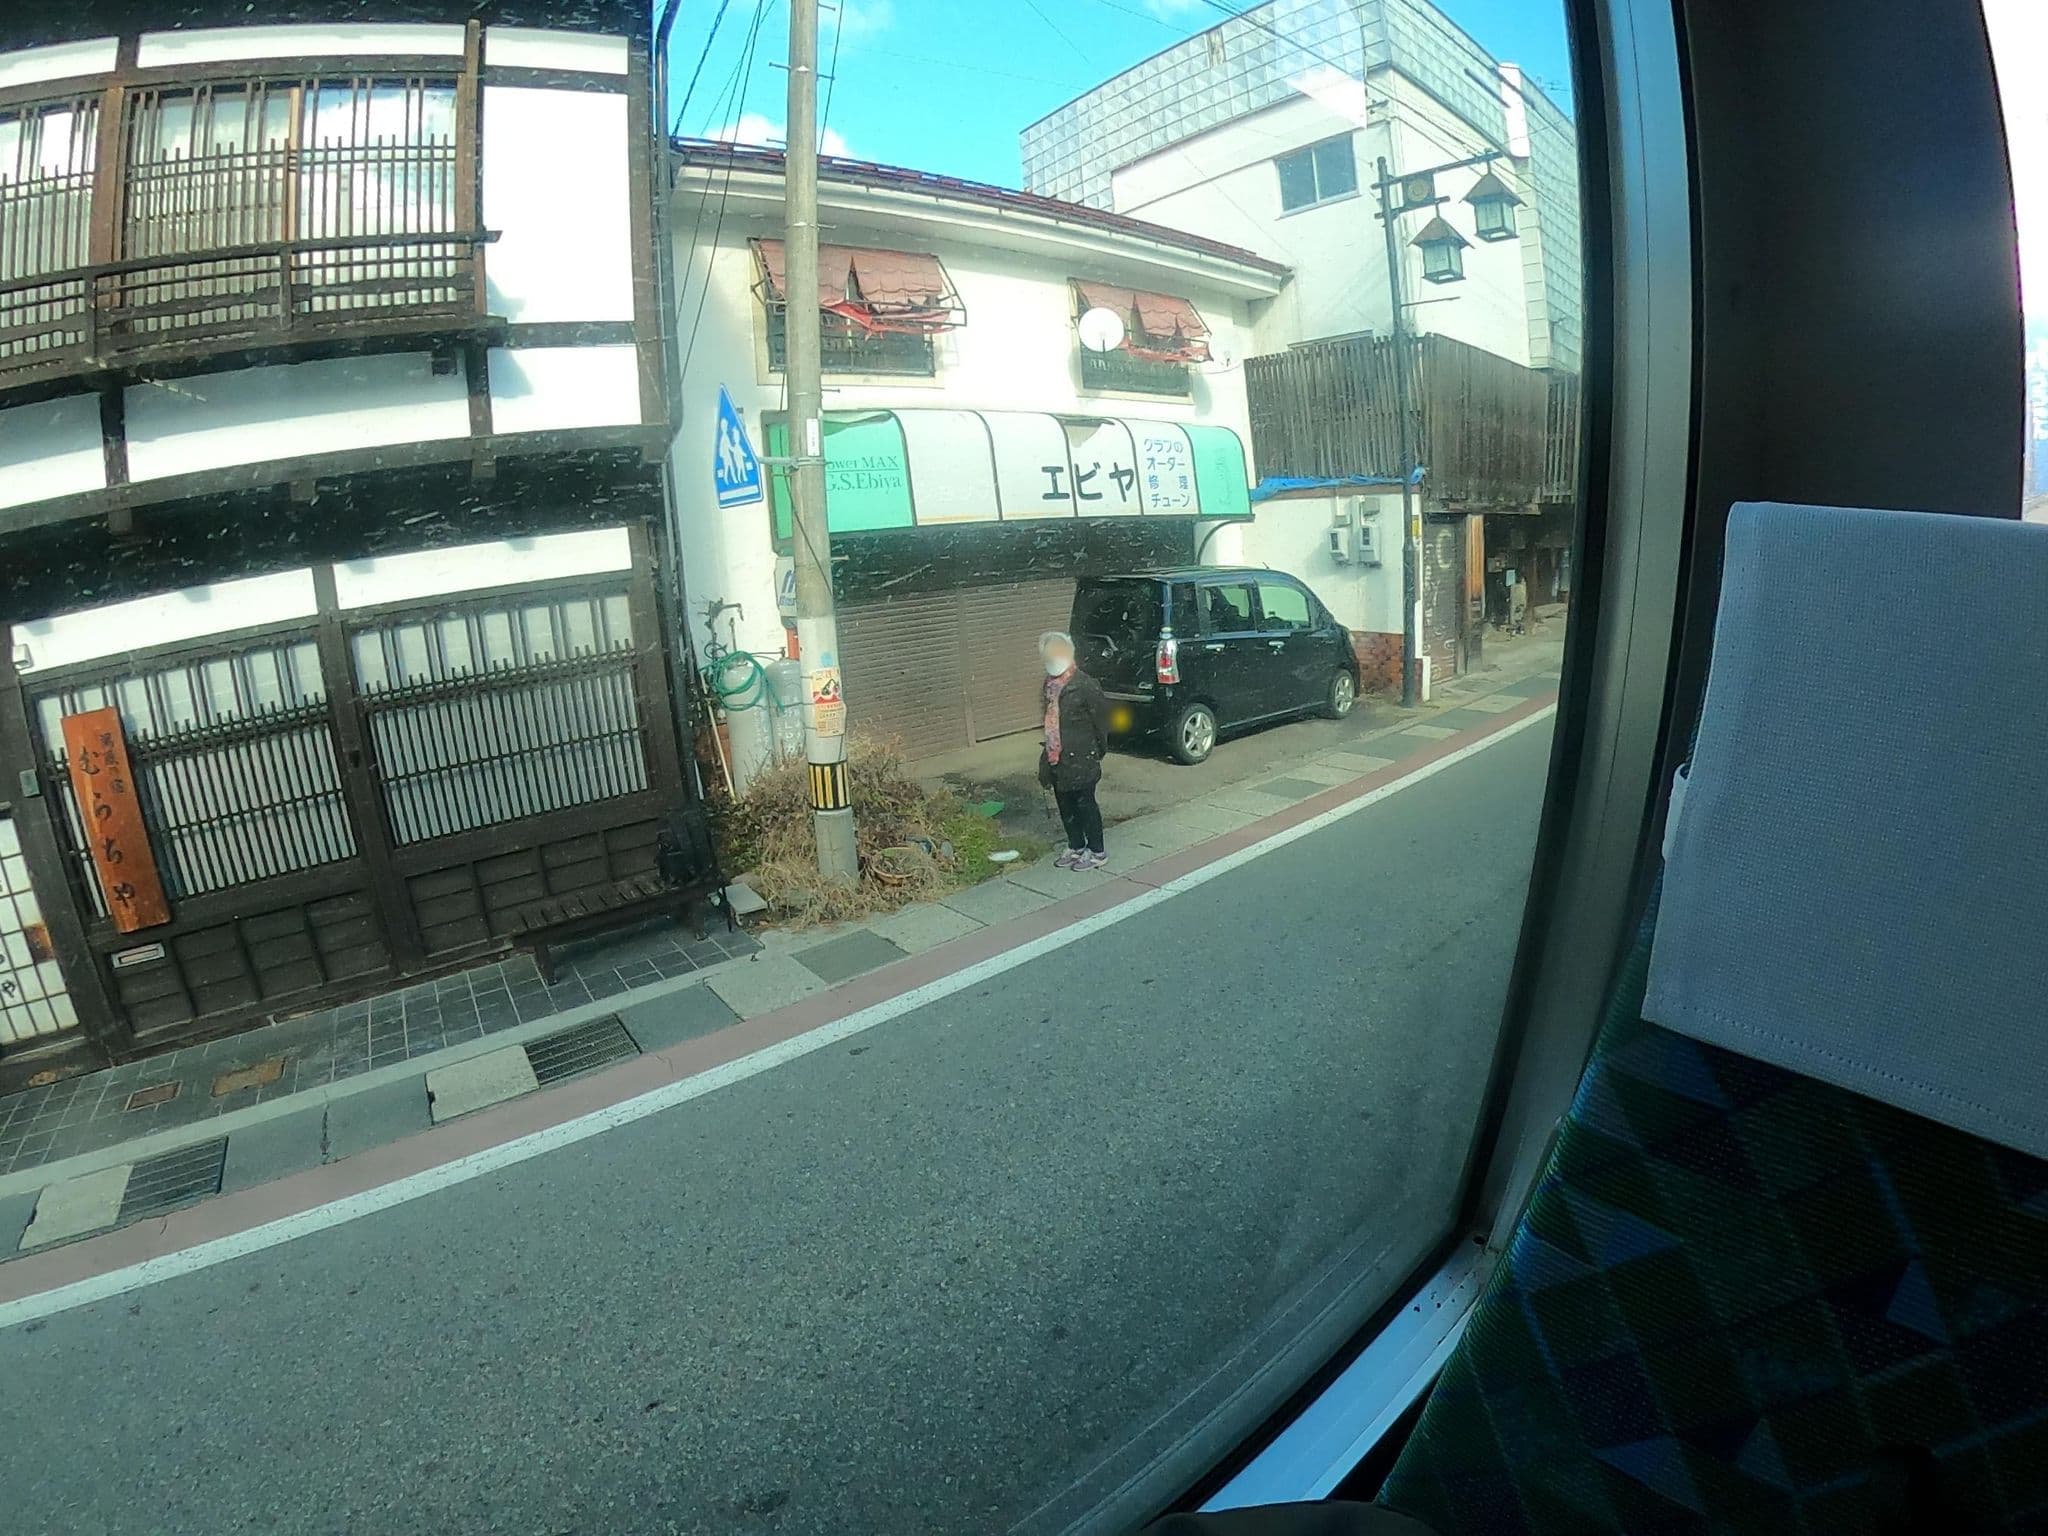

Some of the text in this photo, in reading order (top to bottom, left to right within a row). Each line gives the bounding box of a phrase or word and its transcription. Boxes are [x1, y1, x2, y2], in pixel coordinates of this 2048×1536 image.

[826, 456, 899, 470] ower MAX
[1041, 462, 1134, 502] エビヤ
[1151, 493, 1190, 508] チューン
